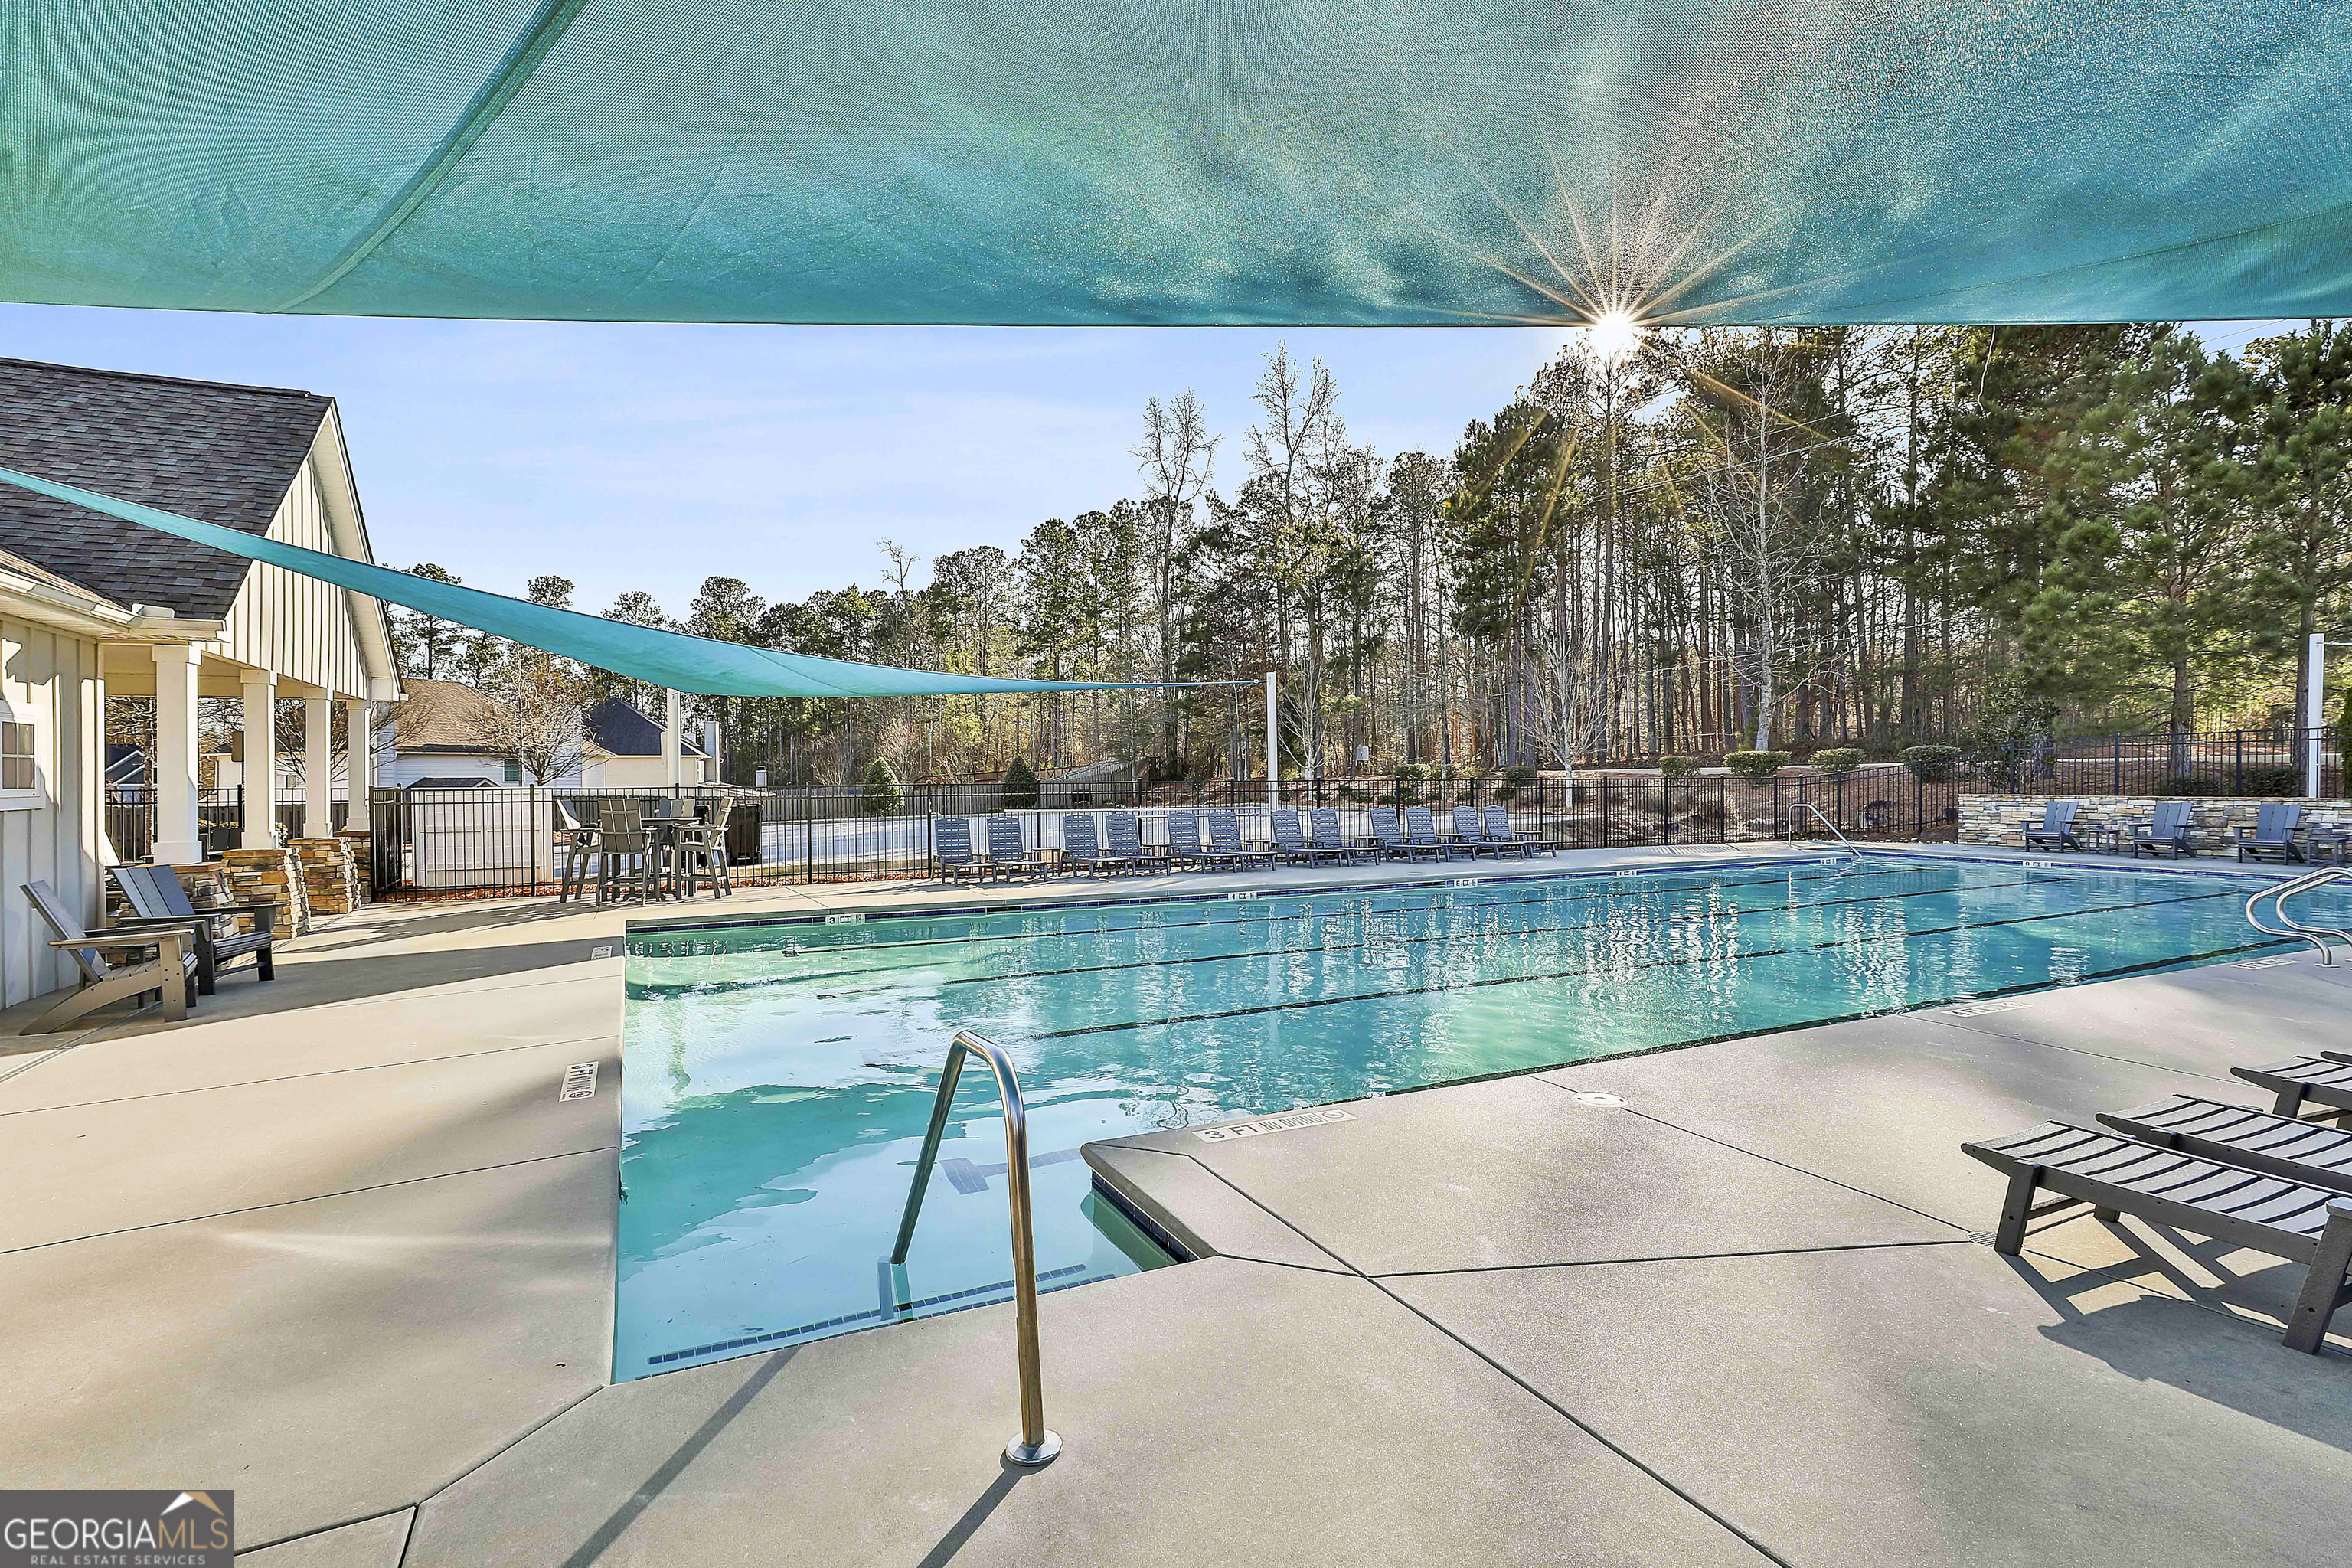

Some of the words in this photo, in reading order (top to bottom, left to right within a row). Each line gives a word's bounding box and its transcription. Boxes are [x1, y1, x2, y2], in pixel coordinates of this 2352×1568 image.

[1204, 1130, 1225, 1139] 3
[1228, 1124, 1259, 1135] FT
[1259, 1121, 1282, 1131] NO
[1279, 1114, 1322, 1128] DIVING
